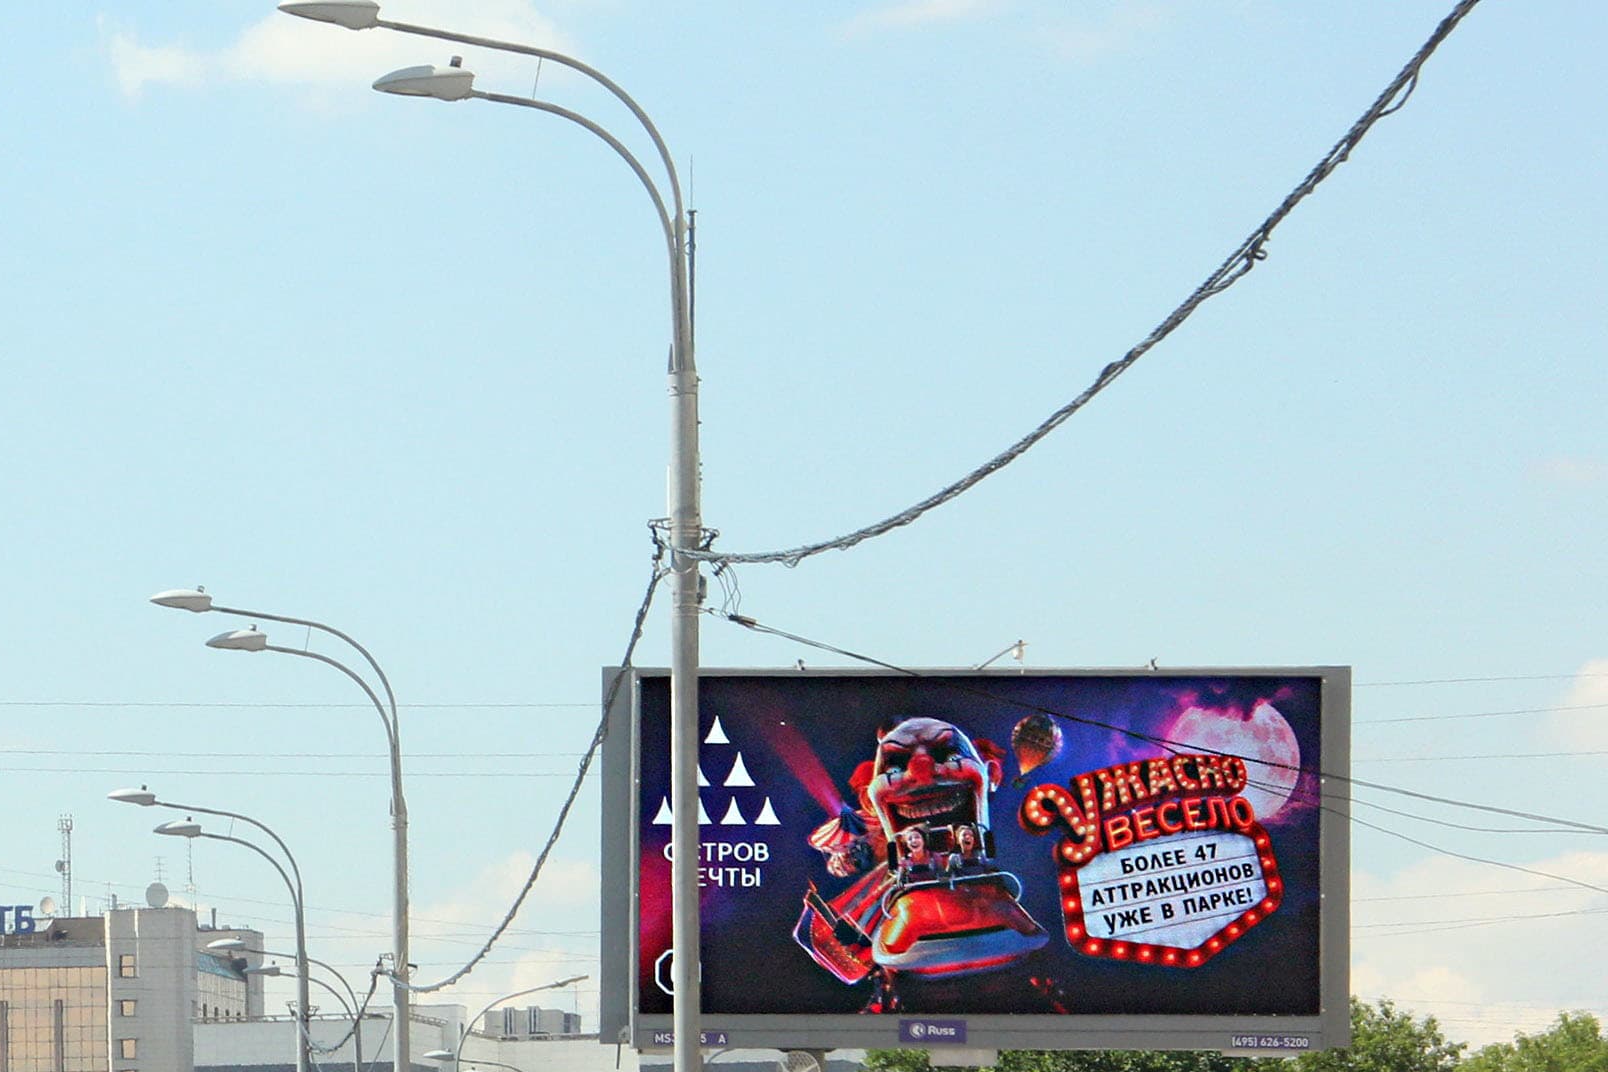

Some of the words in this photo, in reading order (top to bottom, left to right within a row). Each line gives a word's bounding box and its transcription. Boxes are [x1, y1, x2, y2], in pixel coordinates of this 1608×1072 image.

[1020, 754, 1248, 866] УЖАСНО
[1103, 796, 1255, 851] ВЕСЕЛО
[663, 842, 770, 862] ОТРОВ
[1120, 849, 1186, 875] БОЛЕЕ
[1195, 843, 1218, 862] 47
[697, 867, 761, 887] ЕЧТЫ
[1091, 863, 1254, 906] АТТРАКЦИОНОВ
[1103, 907, 1153, 935] УЖЕ
[1161, 902, 1175, 920] В
[1183, 887, 1254, 916] ПАРКЕ!
[927, 1025, 956, 1036] Russ
[1231, 1036, 1258, 1047] (495)
[1260, 1036, 1309, 1048] 626-5200
